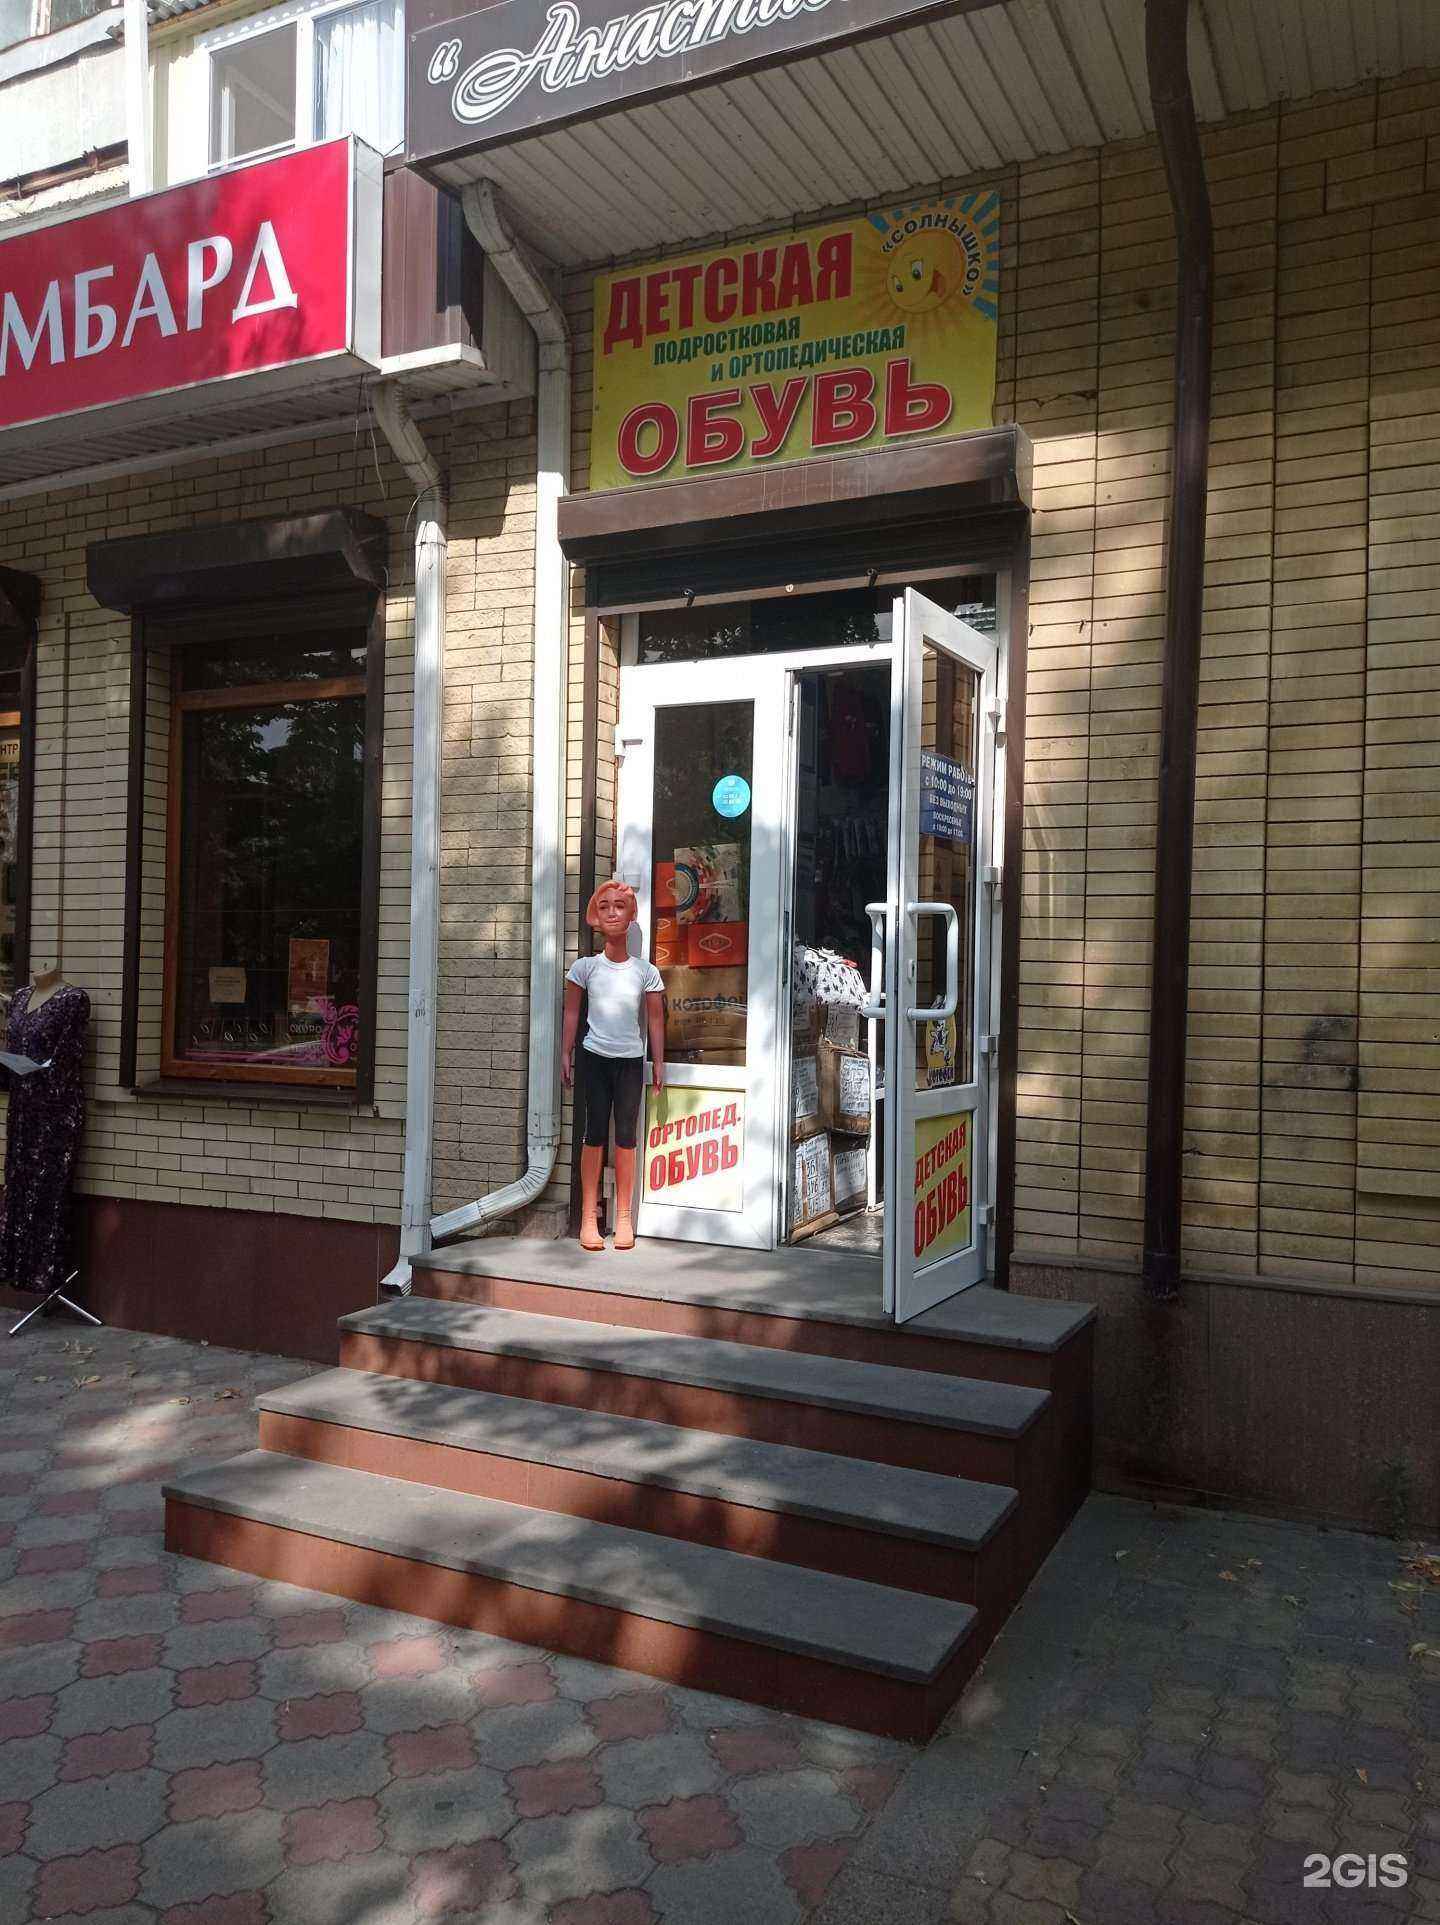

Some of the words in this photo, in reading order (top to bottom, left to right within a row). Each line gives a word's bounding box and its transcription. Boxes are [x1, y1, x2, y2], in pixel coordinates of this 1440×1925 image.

[603, 232, 853, 355] ДЕТСКАЯ
[653, 316, 801, 366] ПОДРОСТКОВАЯ
[728, 325, 906, 380] ОРТОПЕДИЧЕСКАЯ
[617, 357, 953, 477] ОБУВЬ
[921, 754, 947, 775] РЕЖИМ
[931, 775, 948, 792] 10:00
[947, 784, 956, 796] до
[957, 785, 973, 801] 19:00
[649, 1102, 742, 1149] ОРТОПЕД.
[649, 1134, 739, 1192] ОБУВЬ
[914, 1119, 967, 1195] ДЕТСКАЯ
[914, 1160, 968, 1258] ОБУВЬ
